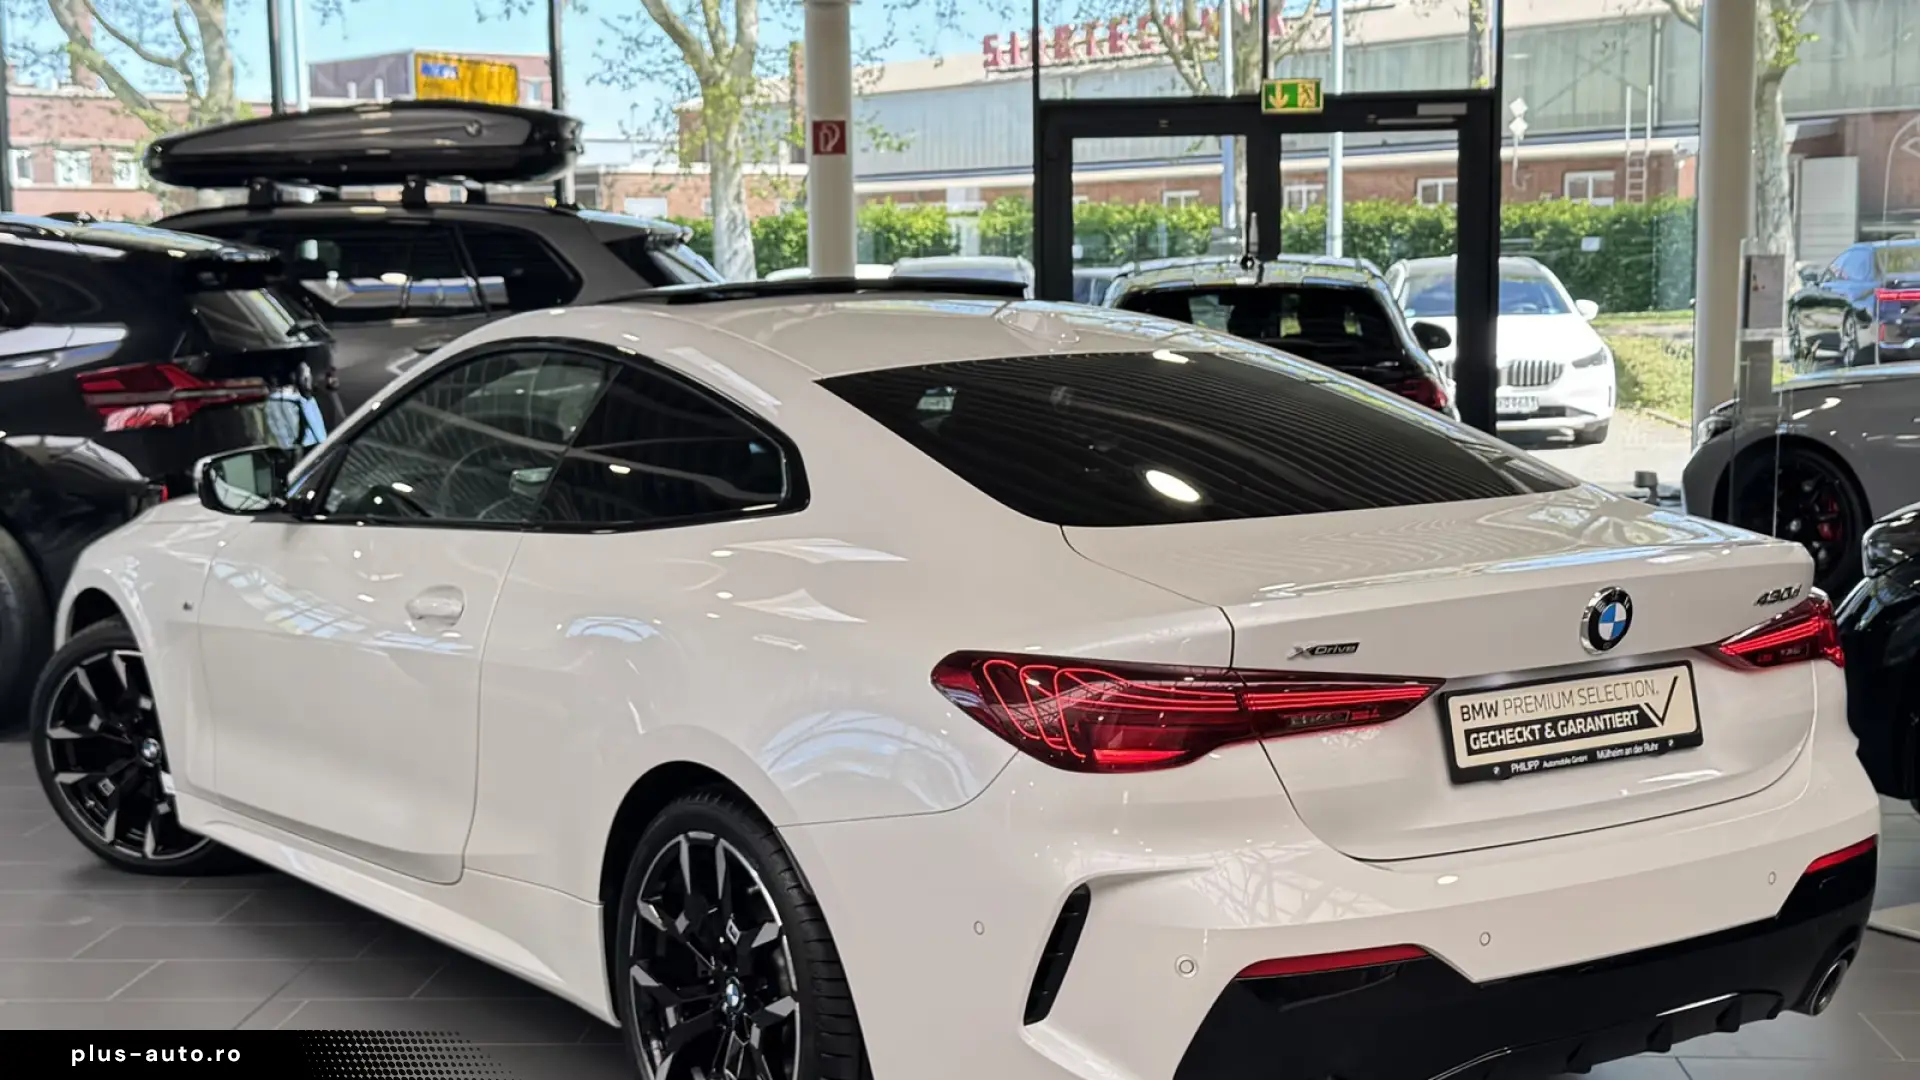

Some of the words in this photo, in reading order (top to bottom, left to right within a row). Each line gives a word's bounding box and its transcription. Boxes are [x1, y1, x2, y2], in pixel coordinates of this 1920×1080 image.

[1753, 584, 1802, 606] 430d
[1460, 700, 1499, 722] BMW
[1503, 690, 1575, 716] PREMIUM
[1469, 724, 1542, 750] GECHECKT
[1544, 722, 1556, 739] &
[1557, 709, 1639, 737] GARANTIERT
[1510, 760, 1540, 773] PHILIPP
[1596, 745, 1624, 760] Mülheim
[1644, 742, 1659, 753] Ruhr
